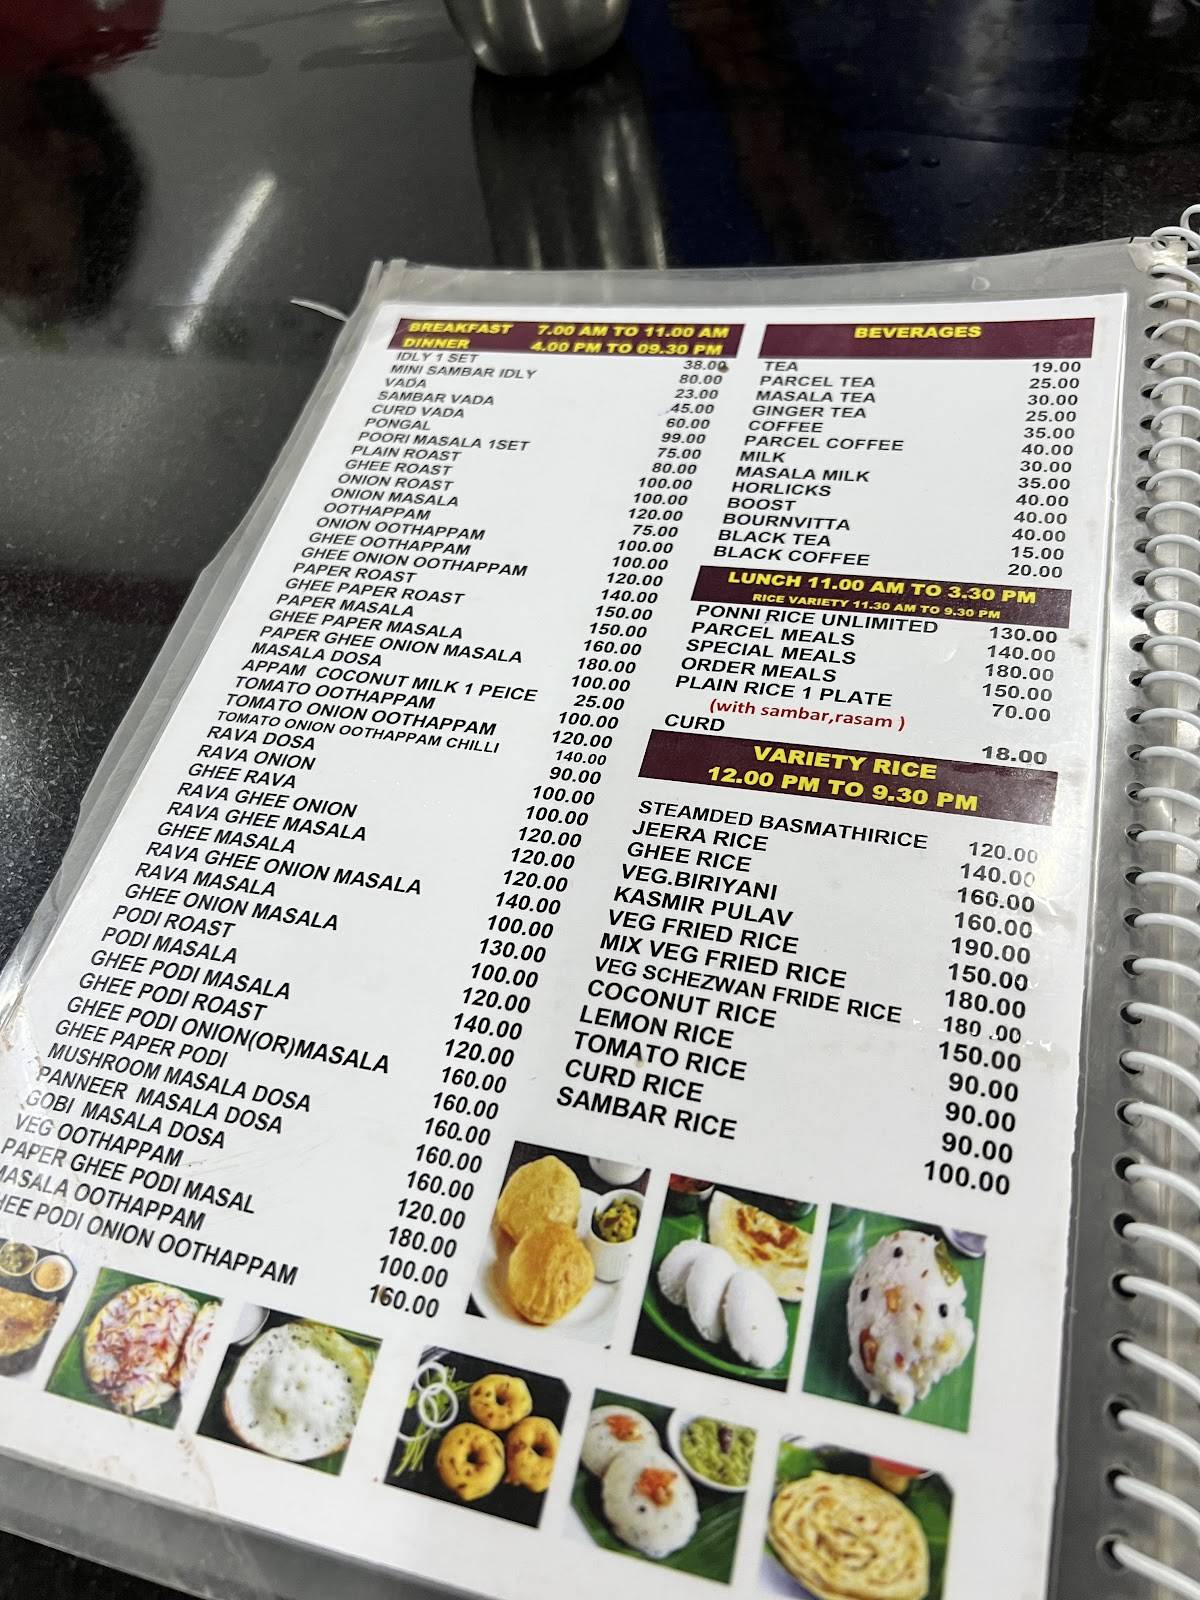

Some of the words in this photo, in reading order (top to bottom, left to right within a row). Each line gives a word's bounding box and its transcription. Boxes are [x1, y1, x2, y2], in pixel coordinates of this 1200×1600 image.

[402, 338, 471, 350] DINNER
[531, 341, 569, 353] 4.00
[573, 343, 601, 353] PM
[607, 343, 633, 354] TO
[636, 343, 688, 355] 09.30
[693, 344, 723, 356] PM
[408, 321, 514, 335] BREAKFAST
[538, 325, 576, 336] 7.00
[578, 326, 608, 337] AM
[613, 326, 639, 337] TO
[645, 327, 694, 338] 11.00
[698, 327, 730, 339] AM
[854, 326, 982, 339] BEVERAGES
[389, 364, 424, 374] MINI
[426, 365, 496, 378] SAMBAR
[498, 368, 537, 380] IDLY
[678, 373, 723, 385] 80.00
[764, 361, 799, 372] TEA
[1032, 361, 1082, 374] 19.00
[385, 377, 427, 388] VADA
[673, 388, 719, 400] 23.00
[755, 389, 833, 403] MASALA
[839, 391, 876, 404] TEA
[1027, 394, 1079, 406] 30.00
[357, 431, 411, 444] POORI
[412, 434, 482, 449] MASALA
[488, 439, 531, 452] 1SET
[657, 447, 702, 460] 75.00
[364, 417, 431, 431] PONGAL
[660, 432, 707, 445] 99.00
[747, 420, 824, 433] COFFEE
[1023, 427, 1075, 440] 35.00
[345, 458, 392, 472] GHEE
[393, 462, 454, 476] ROAST
[638, 477, 693, 490] 100.00
[731, 481, 832, 497] HORLICKS
[1015, 493, 1069, 508] 40.00
[323, 502, 432, 521] OOTHAPPAM
[632, 524, 679, 538] 75.00
[330, 487, 385, 501] ONION
[387, 491, 459, 507] MASALA
[628, 507, 684, 522] 120.00
[722, 512, 851, 531] BOURNVITTA
[1011, 528, 1066, 543] 40.00
[308, 531, 357, 546] GHEE
[359, 535, 472, 556] OOTHAPPAM
[612, 555, 669, 571] 100.00
[712, 545, 784, 561] BLACK
[787, 549, 871, 567] COFFEE
[1007, 563, 1063, 579] 20.00
[292, 562, 352, 578] PAPER
[354, 567, 418, 584] ROAST
[601, 588, 659, 604] 140.00
[728, 571, 802, 588] LUNCH
[808, 576, 865, 591] 11.00
[869, 581, 905, 594] AM
[911, 583, 942, 596] TO
[948, 586, 996, 601] 3.30
[1002, 590, 1036, 604] PM
[695, 604, 761, 621] PONNI
[763, 609, 816, 625] RICE
[821, 613, 939, 634] UNLIMITED
[989, 626, 1058, 644] 130.00
[752, 593, 785, 603] RICE
[789, 596, 849, 608] VARIETY
[853, 600, 890, 611] 11.30
[893, 603, 916, 612] AM
[920, 605, 940, 614] TO
[944, 607, 974, 617] 9.30
[978, 609, 1001, 619] PM
[268, 609, 320, 625] GHEE
[320, 614, 384, 631] PAPER
[385, 620, 463, 640] MASALA
[583, 639, 642, 656] 160.00
[250, 641, 325, 661] MASALA
[329, 649, 382, 667] DOSA
[571, 674, 631, 693] 100.00
[685, 638, 774, 659] SPECIAL
[780, 646, 857, 665] MEALS
[984, 663, 1054, 682] 180.00
[240, 659, 308, 677] APPAM
[315, 666, 410, 688] COCONUT
[411, 676, 460, 694] MILK
[465, 682, 474, 695] 1
[478, 683, 539, 702] PEICE
[572, 694, 625, 711] 25.00
[709, 698, 756, 715] (with
[760, 706, 893, 728] sambar,rasam
[206, 725, 258, 744] RAVA
[261, 731, 315, 751] DOSA
[549, 766, 602, 785] 90.00
[217, 710, 282, 727] TOMATO
[284, 718, 336, 734] ONION
[338, 724, 443, 747] OOTHAPPAM
[446, 737, 500, 754] CHILLI
[555, 749, 607, 766] 140.00
[664, 713, 726, 732] CURD
[981, 745, 1048, 765] 18.00
[754, 746, 867, 771] VARIETY
[873, 759, 938, 780] RICE
[708, 766, 774, 788] 12.00
[780, 774, 820, 793] PM
[828, 779, 864, 798] TO
[872, 785, 928, 805] 9.30
[936, 791, 978, 812] PM
[176, 781, 229, 801] RAVA
[234, 789, 291, 809] GHEE
[292, 796, 359, 818] ONION
[518, 826, 582, 848] 120.00
[638, 800, 754, 827] STEAMDED
[758, 814, 929, 850] BASMATHIRICE
[968, 841, 1038, 864] 120.00
[622, 863, 778, 901] VEG.BIRIYANI
[954, 911, 1033, 939] 160.00
[124, 883, 182, 906] GHEE
[182, 892, 250, 917] ONION
[250, 902, 338, 931] MASALA
[479, 938, 547, 963] 130.00
[613, 885, 705, 915] KASMIR
[710, 899, 794, 927] PULAV
[951, 936, 1031, 965] 190.00
[100, 926, 153, 949] PODI
[151, 935, 238, 965] MASALA
[462, 986, 531, 1014] 120.00
[67, 995, 125, 1022] GHEE
[125, 1006, 179, 1032] PODI
[181, 1017, 389, 1074] ONION(OR)MASALA
[441, 1066, 507, 1094] 160.00
[587, 979, 711, 1016] COCONUT
[715, 1000, 777, 1029] RICE
[938, 1040, 1022, 1073] 150.00
[47, 1042, 163, 1080] MUSHROOM
[162, 1066, 247, 1100] MASALA
[251, 1084, 311, 1113] DOSA
[424, 1116, 492, 1147] 160.00
[574, 1030, 680, 1068] TOMATO
[685, 1051, 748, 1082] RICE
[945, 1101, 1016, 1133] 90.00
[556, 1085, 668, 1126] SAMBAR
[673, 1108, 738, 1141] RICE
[924, 1159, 1011, 1196] 100.00
[15, 1113, 54, 1137] VEG
[56, 1122, 185, 1167] OOTHAPPAM
[397, 1198, 467, 1230] 120.00
[1, 1137, 68, 1168] PAPER
[70, 1153, 128, 1182] GHEE
[128, 1166, 182, 1195] PODI
[182, 1179, 255, 1215] MASAL
[388, 1225, 458, 1259] 180.00
